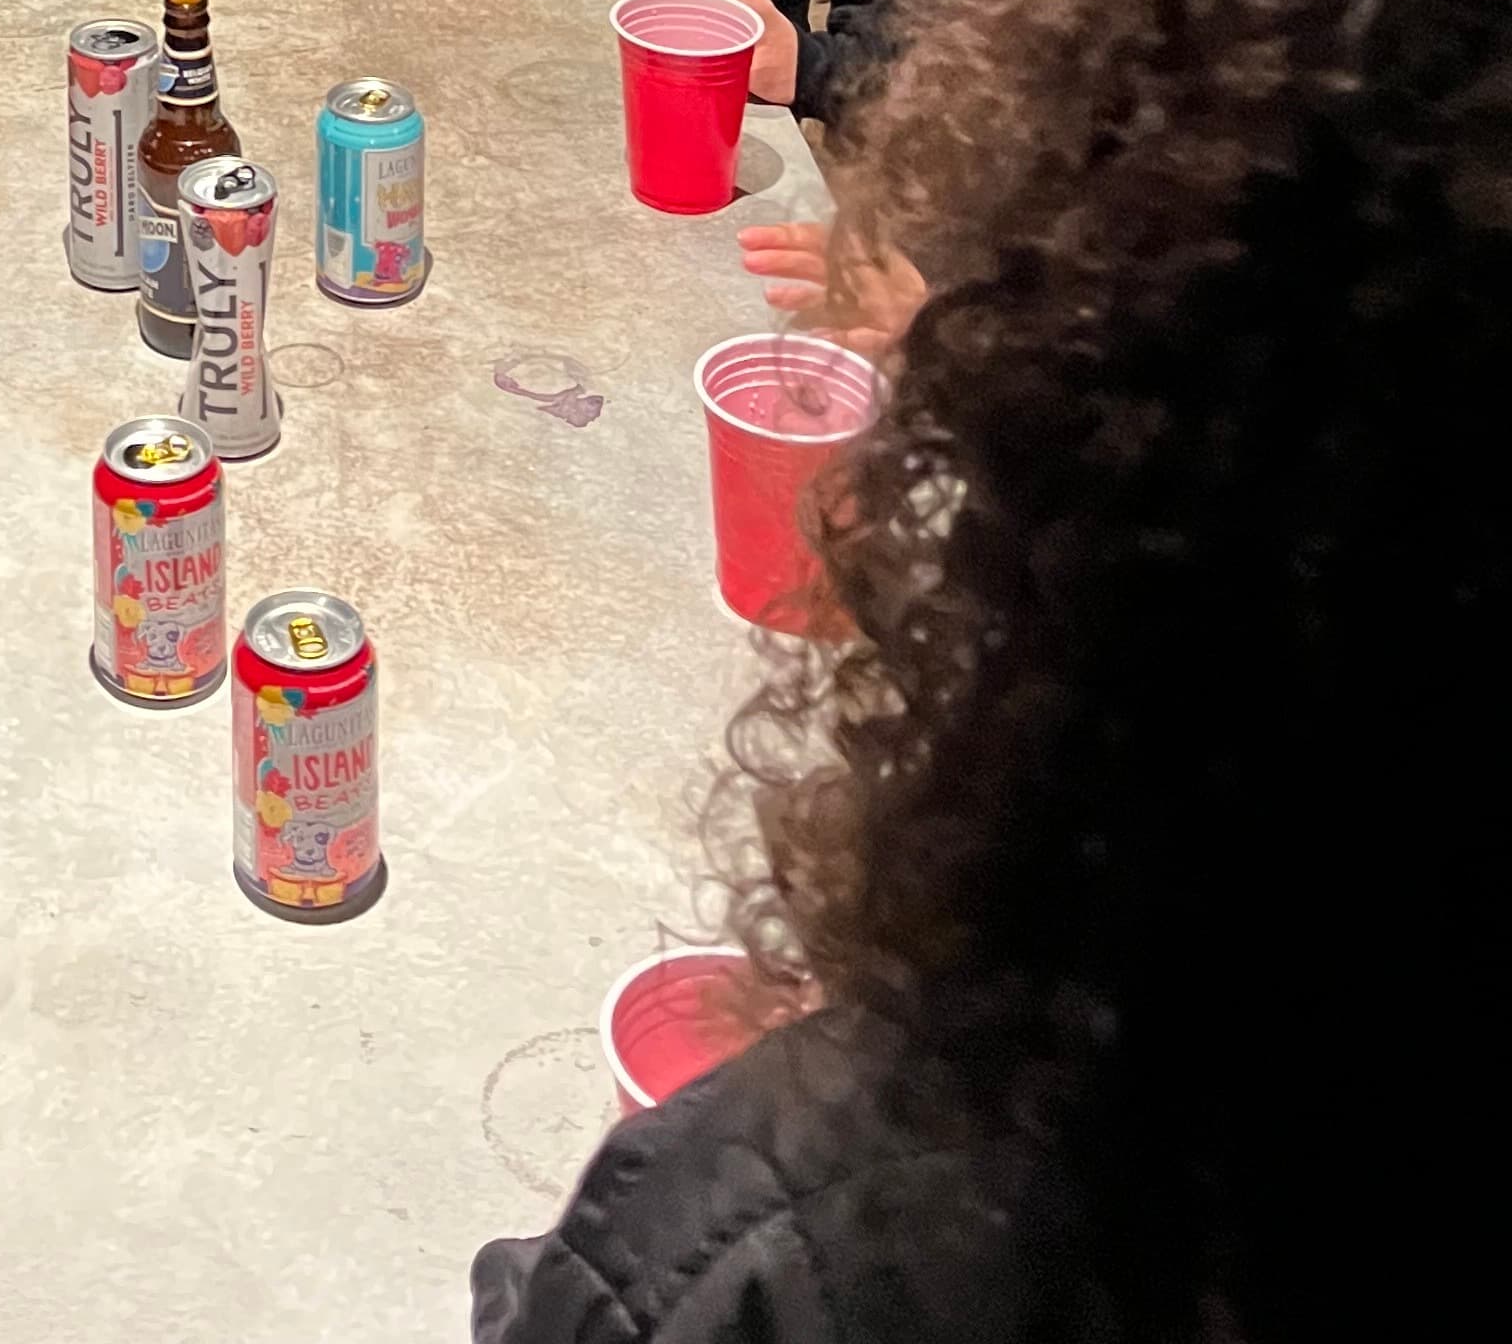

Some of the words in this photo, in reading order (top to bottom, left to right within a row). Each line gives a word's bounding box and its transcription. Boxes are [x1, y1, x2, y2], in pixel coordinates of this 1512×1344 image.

[70, 99, 94, 243] TRULY
[94, 138, 108, 185] BERRY
[95, 189, 108, 227] WILD
[198, 260, 238, 422] TRULY
[240, 300, 256, 350] BERRY
[241, 354, 256, 397] WILD
